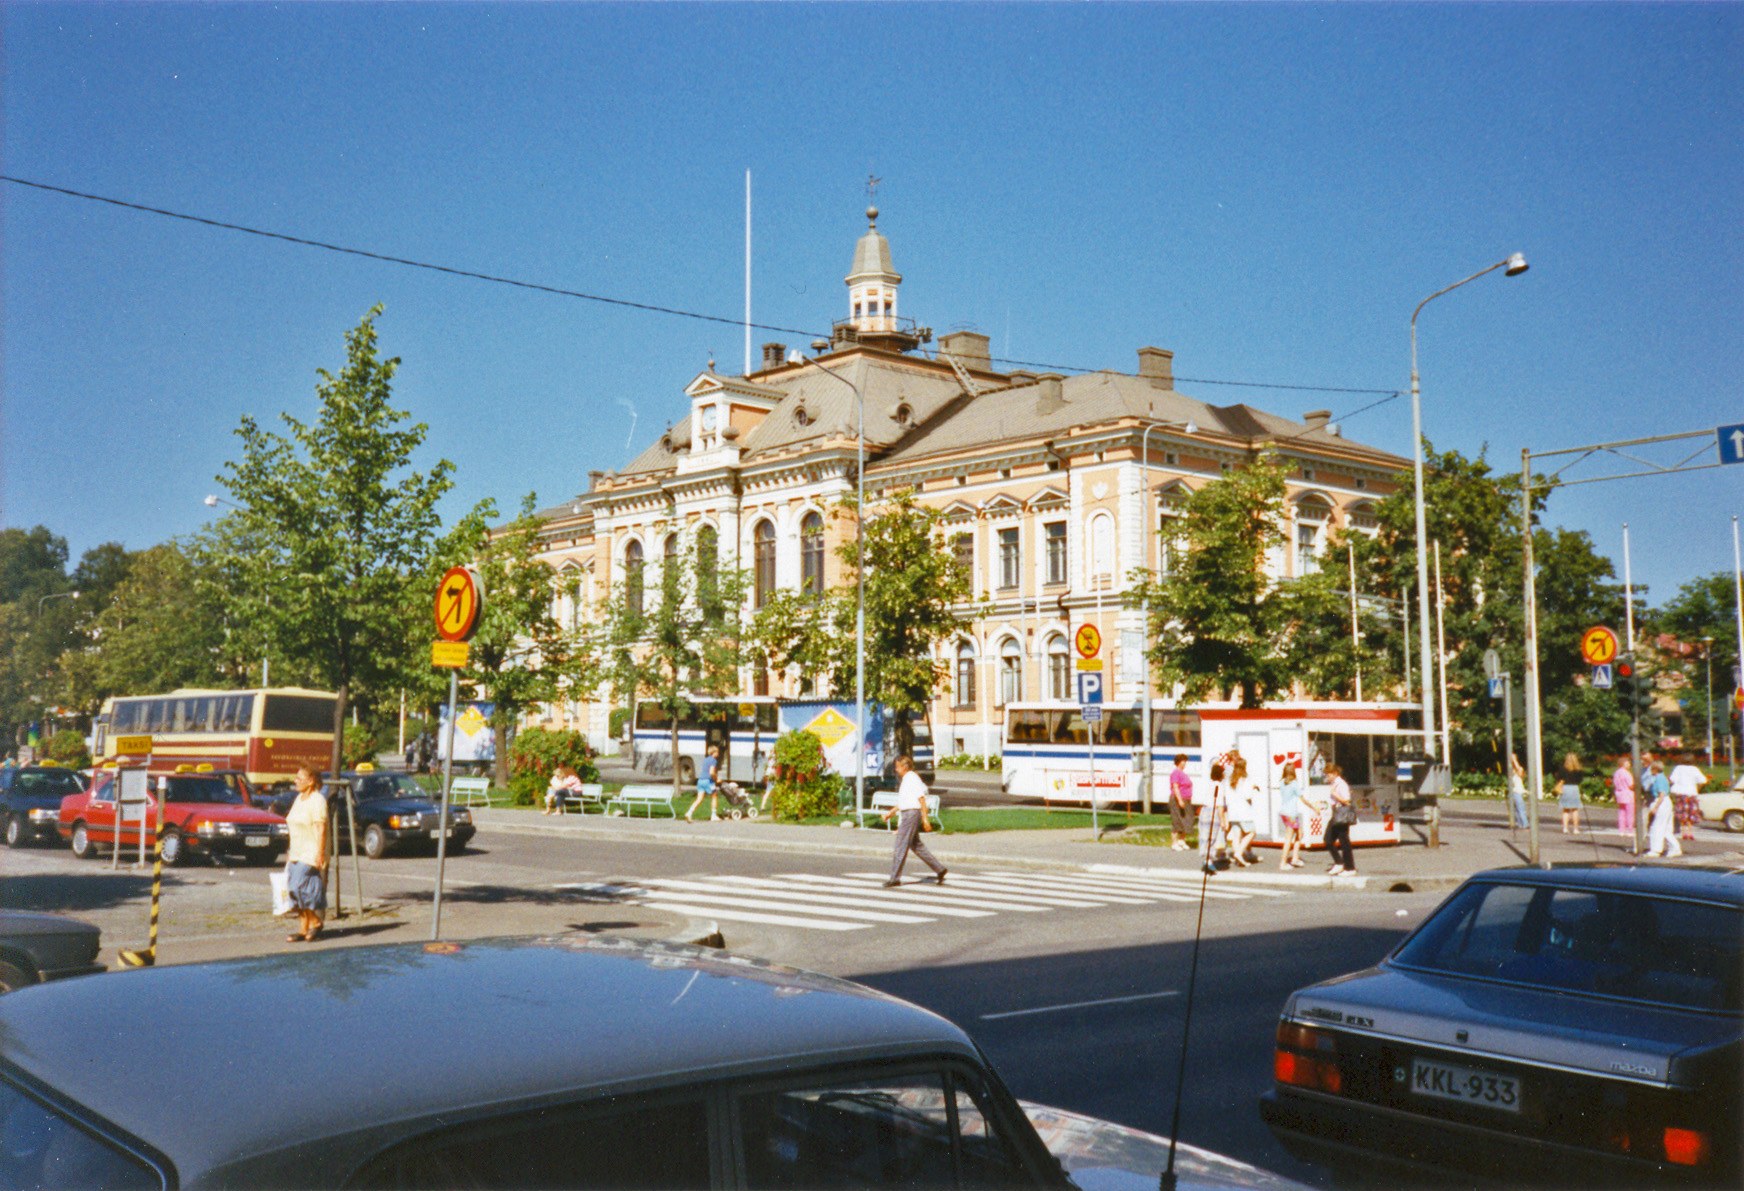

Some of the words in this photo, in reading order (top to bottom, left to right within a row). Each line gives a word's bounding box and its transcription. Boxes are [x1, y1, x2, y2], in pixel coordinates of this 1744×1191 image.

[1082, 674, 1100, 703] P
[121, 740, 150, 750] TAKSI
[1416, 1064, 1517, 1105] KKL-933
